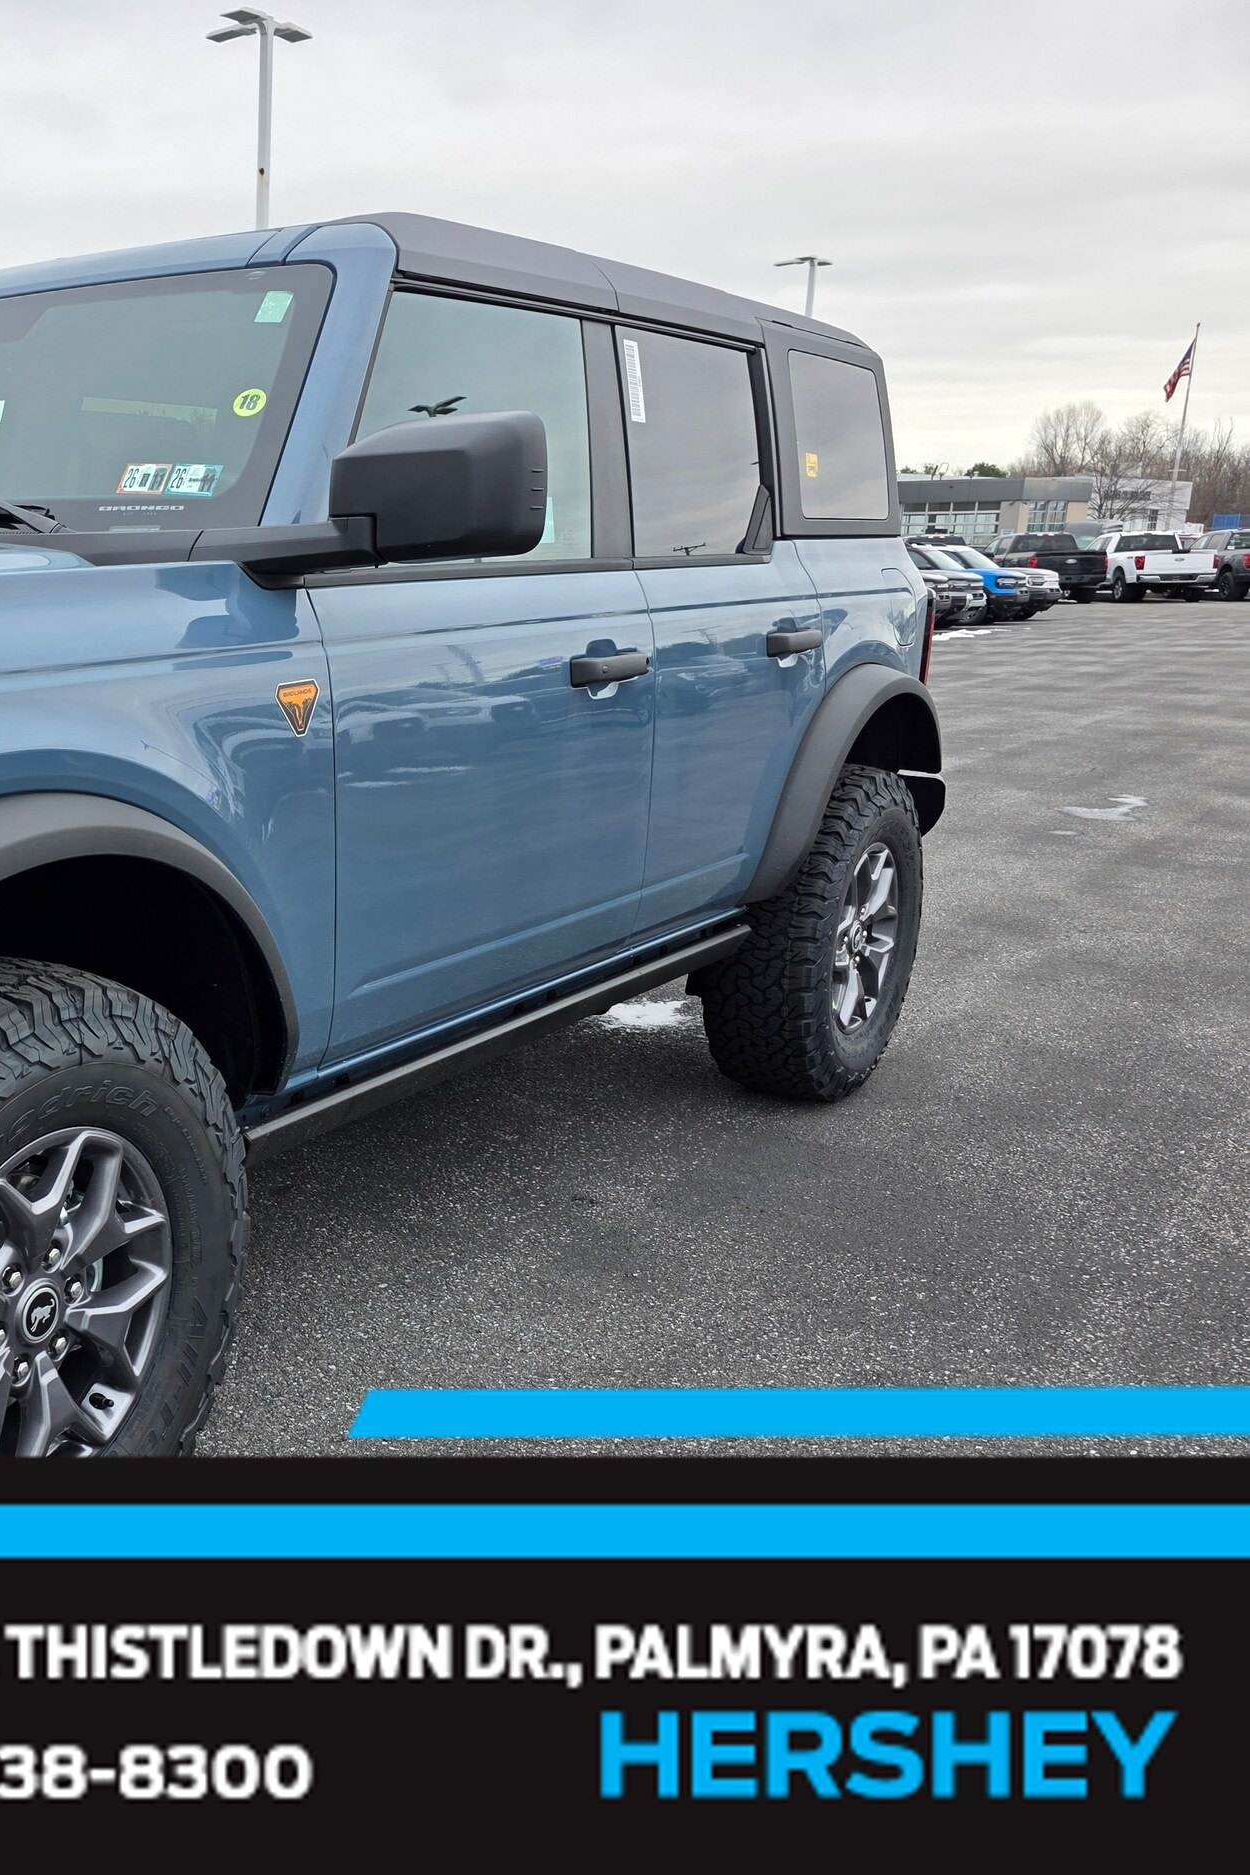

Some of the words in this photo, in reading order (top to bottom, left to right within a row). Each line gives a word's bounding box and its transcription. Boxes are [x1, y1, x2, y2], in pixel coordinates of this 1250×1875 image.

[239, 394, 261, 410] 18
[123, 468, 140, 488] 26
[170, 468, 188, 489] 26
[283, 688, 313, 697] BADLANDS
